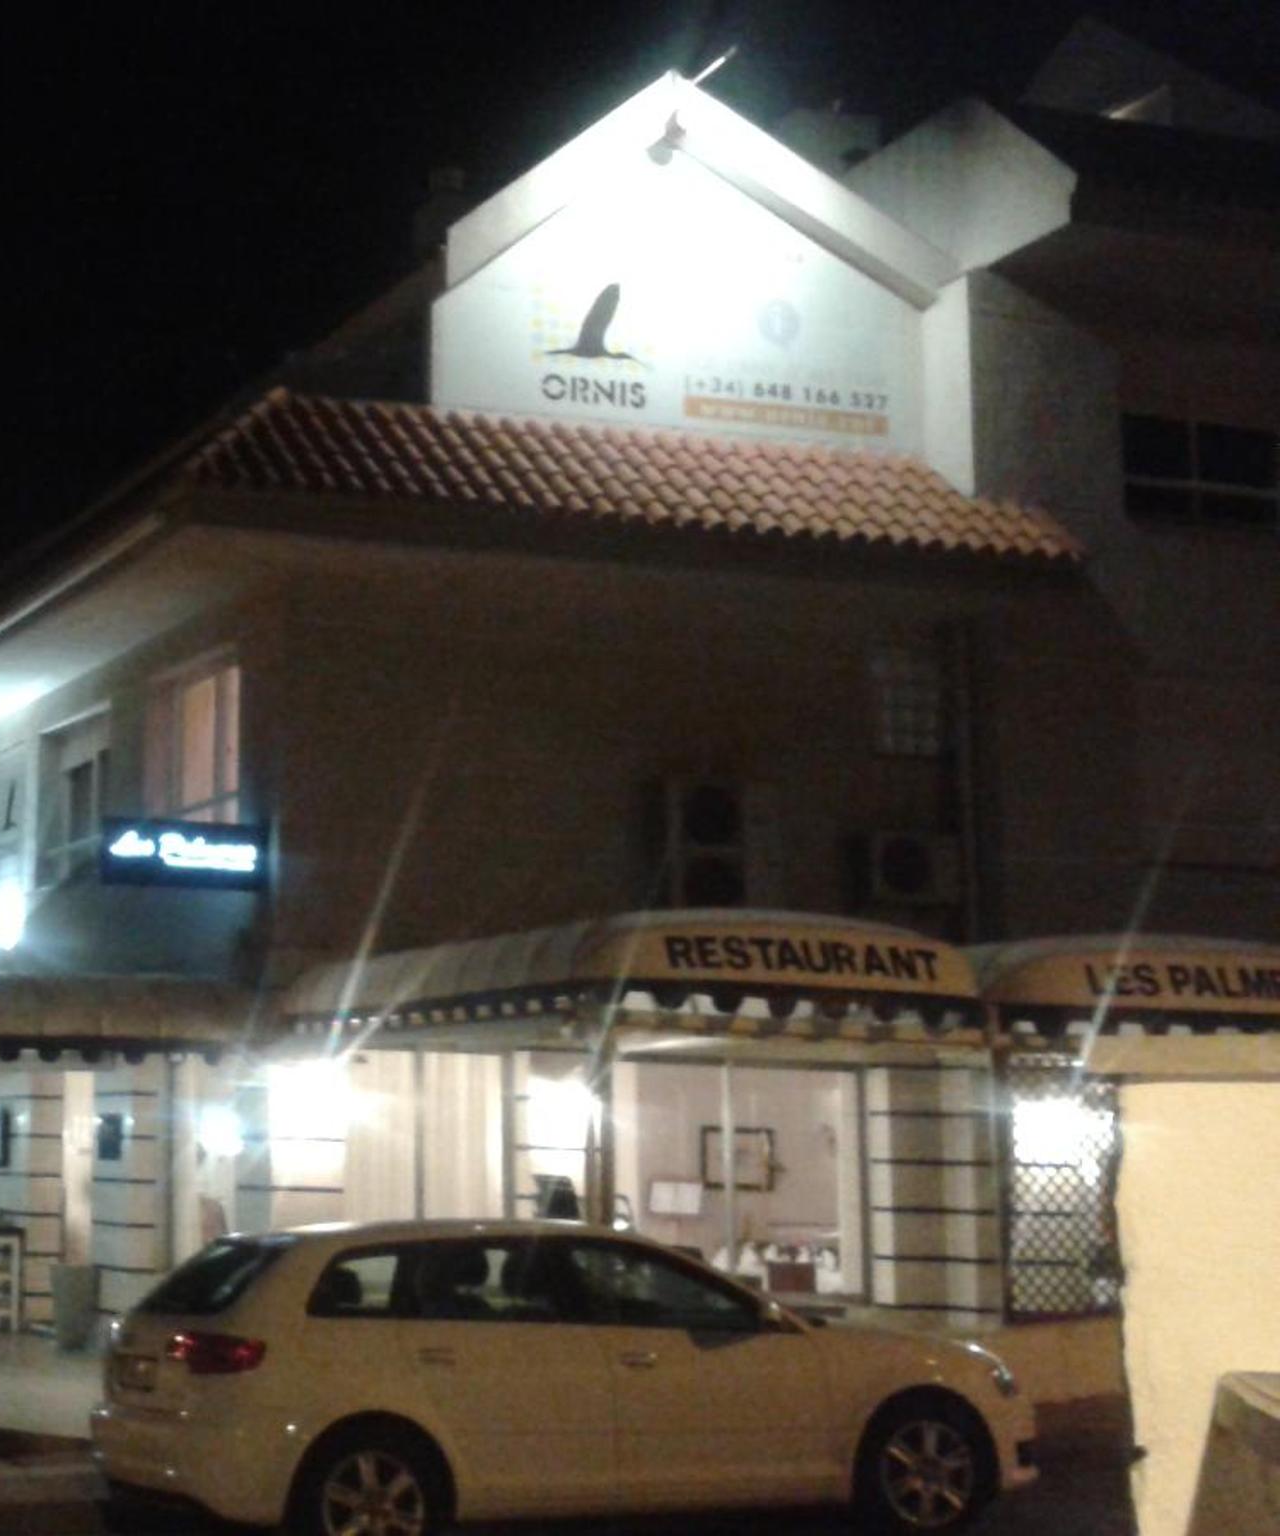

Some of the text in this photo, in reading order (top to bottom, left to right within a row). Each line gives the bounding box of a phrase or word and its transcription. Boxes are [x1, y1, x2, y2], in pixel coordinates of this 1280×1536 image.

[540, 373, 647, 410] ORNIS
[802, 385, 841, 406] 166
[664, 935, 938, 982] RESTAURANT
[1083, 961, 1161, 997] LES
